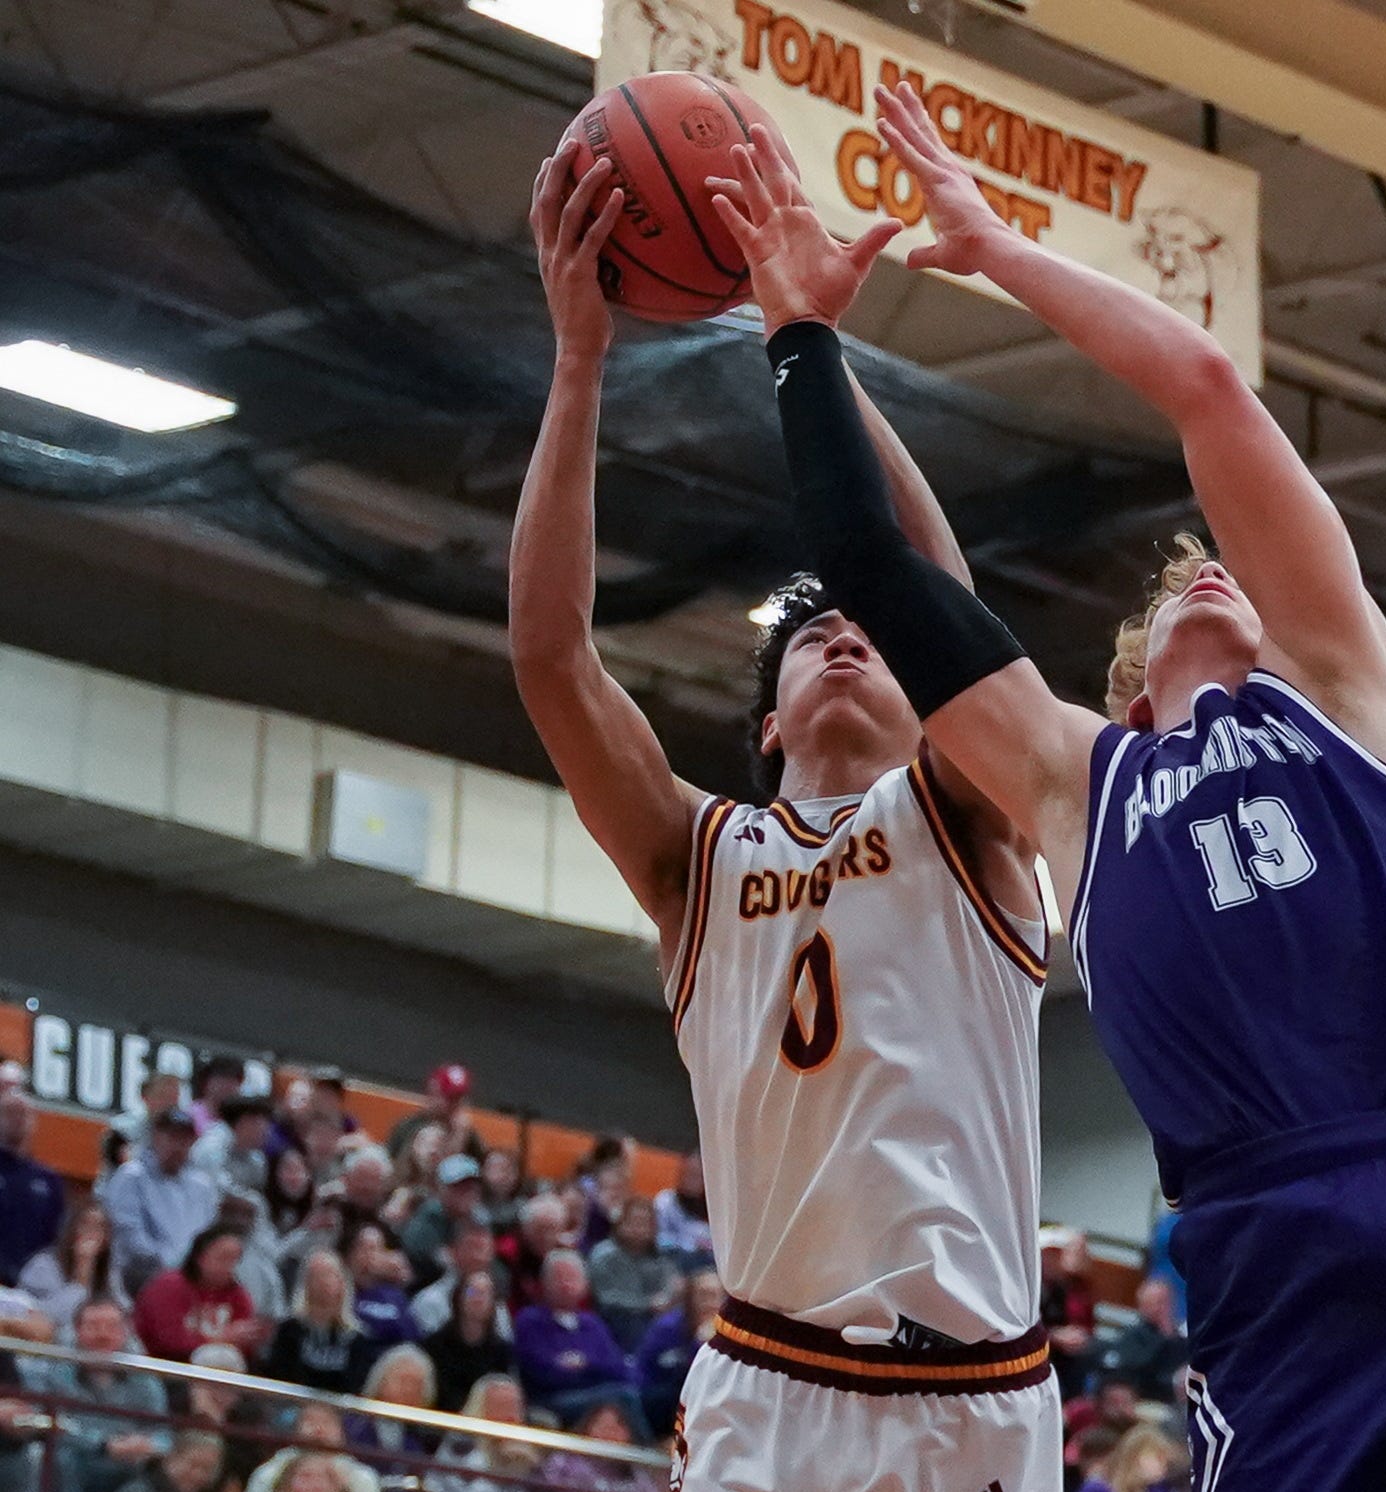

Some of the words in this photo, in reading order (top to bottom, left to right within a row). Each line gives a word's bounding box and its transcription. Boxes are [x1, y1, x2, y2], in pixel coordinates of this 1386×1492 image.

[735, 0, 863, 115] TOM
[837, 127, 1053, 242] COT
[738, 827, 891, 922] COUGRS
[1188, 795, 1318, 912] 13
[779, 923, 844, 1076] 0
